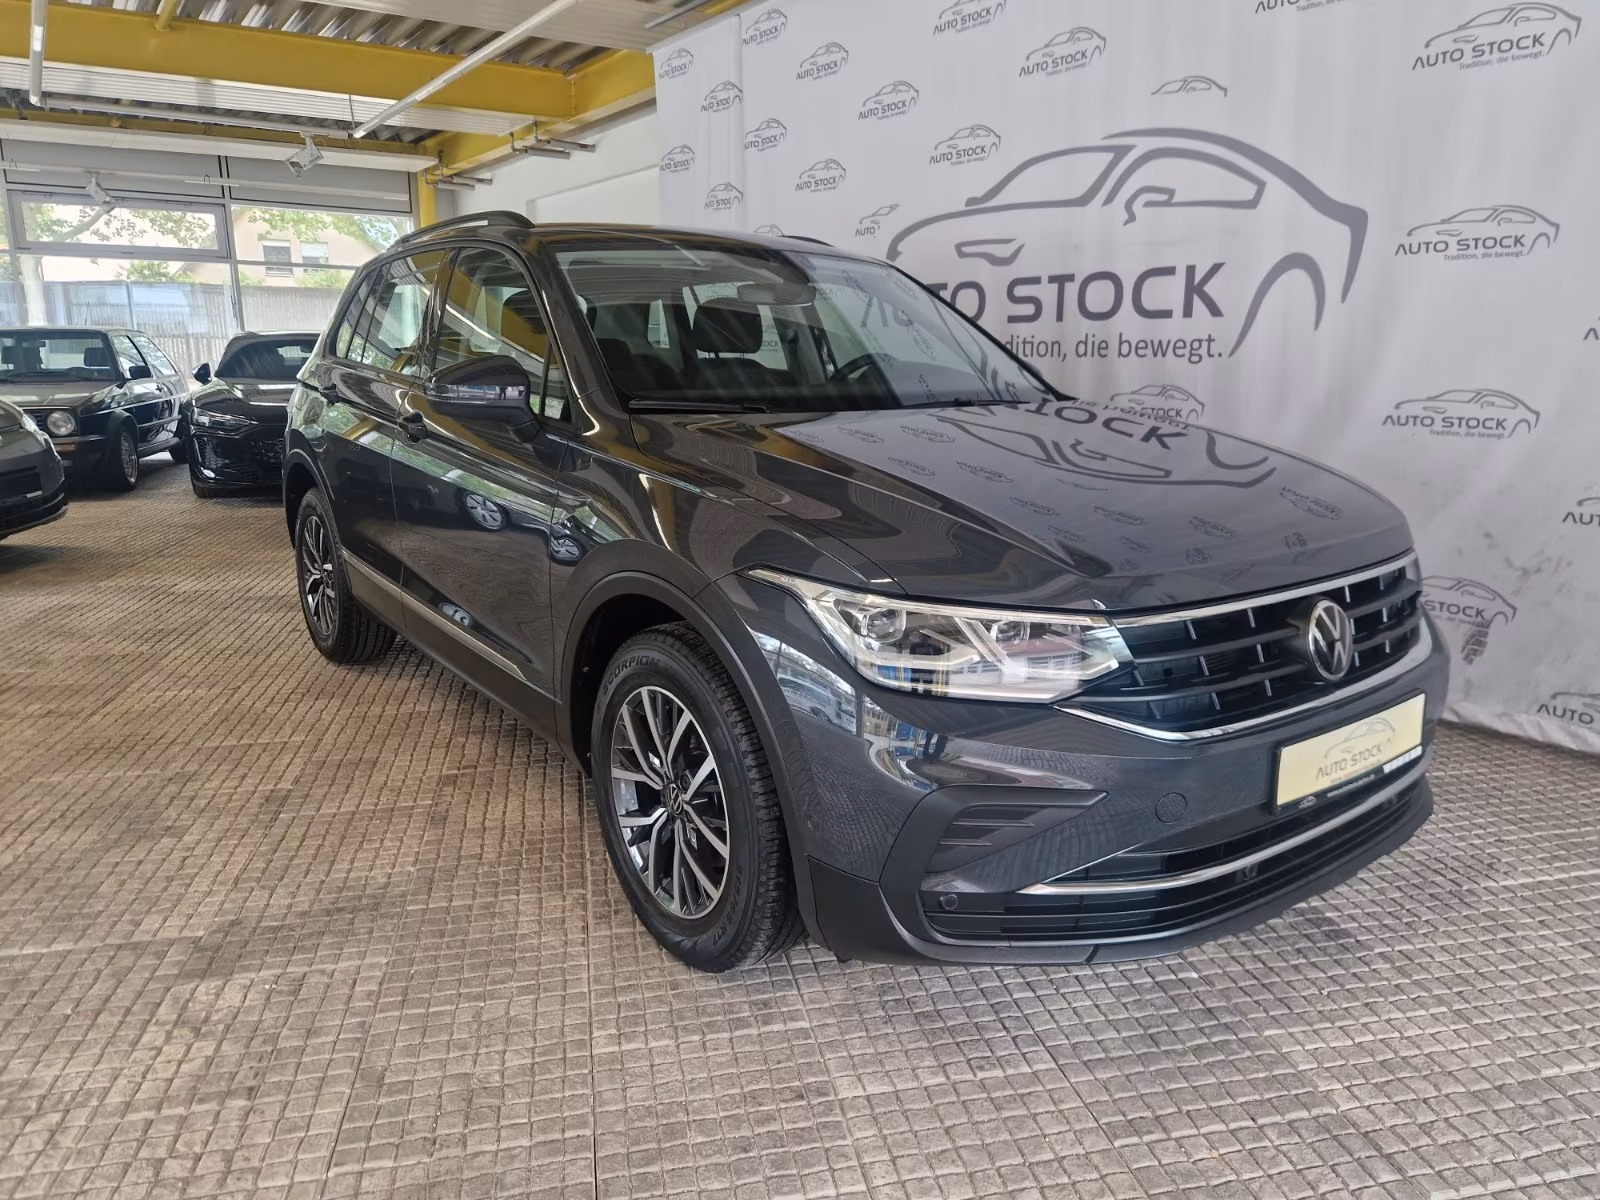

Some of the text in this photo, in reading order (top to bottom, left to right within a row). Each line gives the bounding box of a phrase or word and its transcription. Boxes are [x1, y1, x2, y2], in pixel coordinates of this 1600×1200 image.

[933, 19, 958, 35] AUTO
[960, 6, 992, 26] STOCK
[742, 34, 758, 46] AUTO
[759, 25, 779, 40] STOCK
[1412, 32, 1546, 71] AUTO STOCK
[671, 62, 688, 75] STOCK
[796, 68, 815, 80] AUTO
[815, 60, 839, 75] STOCK
[1019, 61, 1049, 78] AUTO
[1051, 49, 1089, 69] STOCK
[858, 106, 879, 120] AUTO
[881, 99, 907, 115] STOCK
[760, 134, 778, 147] STOCK
[673, 159, 690, 169] STOCK
[929, 152, 953, 165] AUTO
[956, 144, 987, 160] STOCK
[795, 181, 813, 192] AUTO
[814, 176, 837, 189] STOCK
[855, 226, 876, 238] AUTO
[1395, 234, 1526, 256] AUTO STOCK
[1443, 249, 1526, 261] Tradition, die bewegt.
[1006, 262, 1226, 324] STOCK
[1004, 332, 1223, 365] dition, die bewegt.
[1382, 415, 1508, 431] AUTO STOCK
[1423, 599, 1486, 620] STOCK
[1536, 703, 1595, 725] AUTO
[1315, 758, 1348, 781] AUTO
[1350, 742, 1384, 767] STOCK
